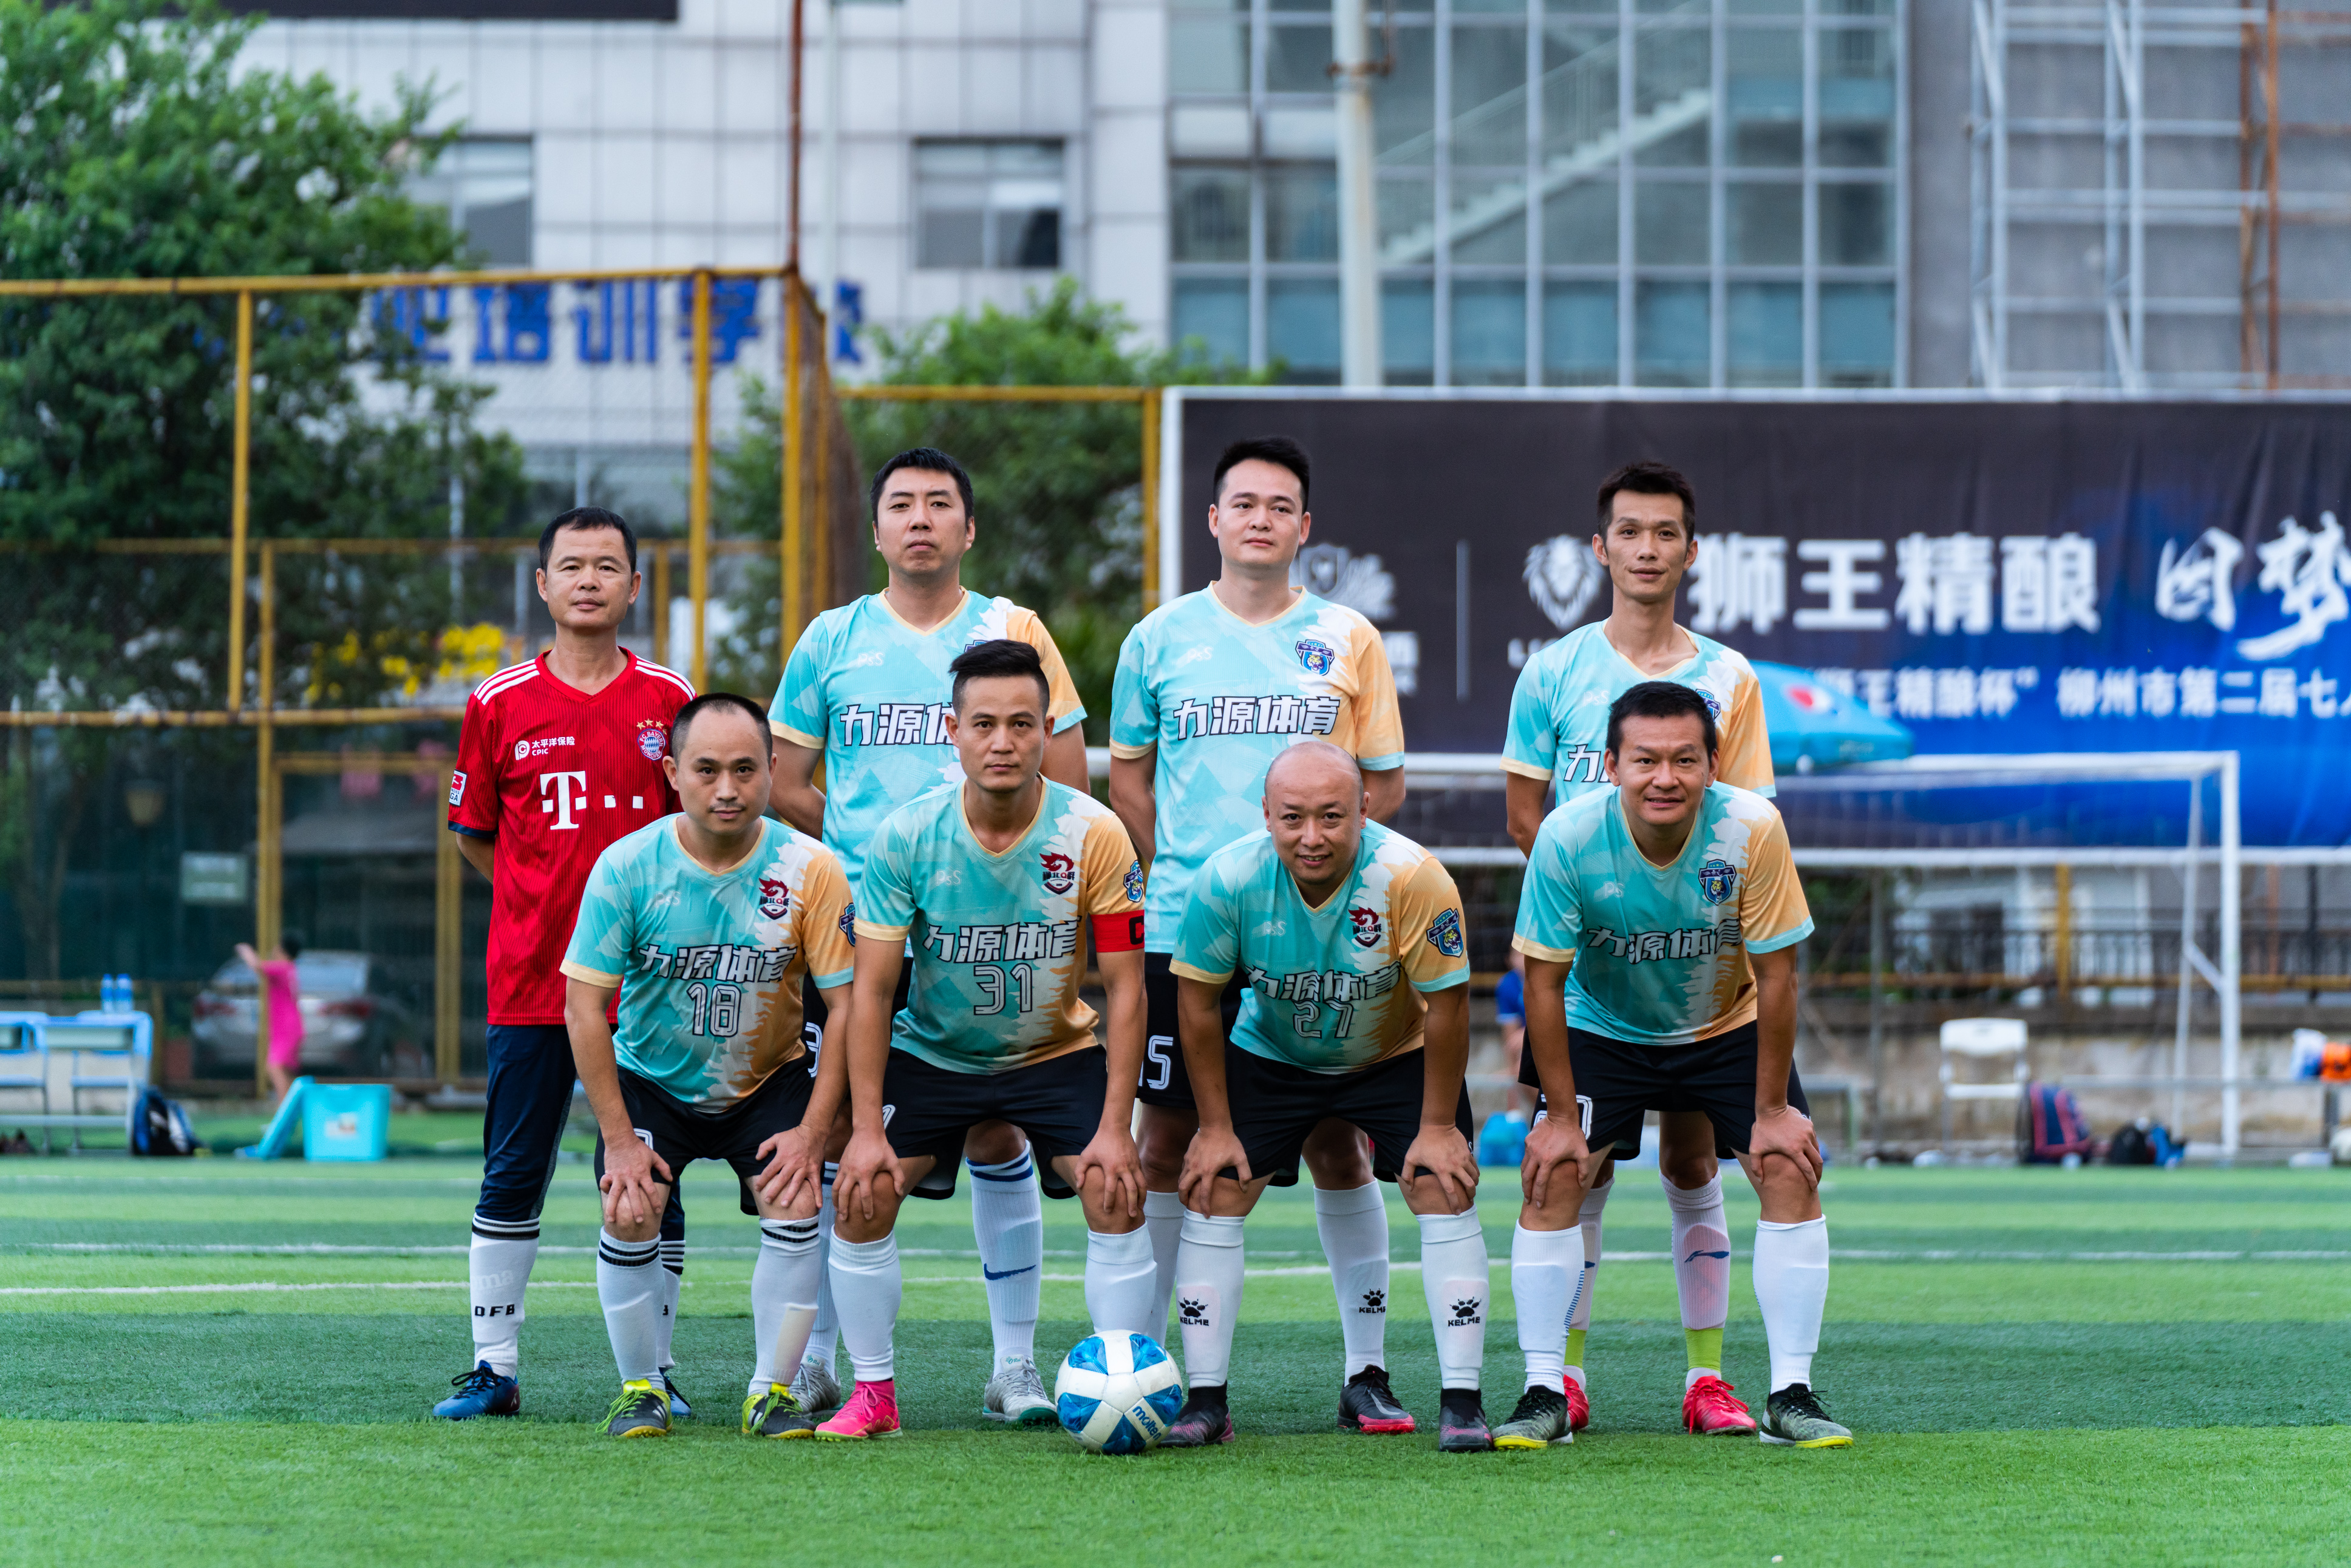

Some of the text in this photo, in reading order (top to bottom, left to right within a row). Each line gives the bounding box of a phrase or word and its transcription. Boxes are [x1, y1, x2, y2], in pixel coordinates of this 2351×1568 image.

[1687, 532, 2101, 635] 狮王精酿
[2057, 666, 2351, 719] 柳州市第二届七
[840, 702, 956, 746] 力源体
[1174, 694, 1340, 741] 力源体育
[531, 736, 575, 749] 太平洋保险
[531, 748, 549, 756] CPIC
[647, 731, 664, 747] BAYERN
[450, 792, 458, 802] GA
[922, 915, 1083, 963] 力源体育
[1129, 915, 1144, 945] C
[1586, 918, 1743, 965] 力源体育
[638, 943, 798, 983] 力源体育
[1244, 960, 1401, 1002] 力源体育
[686, 982, 741, 1037] 18
[973, 963, 1032, 1016] 31
[1293, 999, 1354, 1039] 27
[1179, 1316, 1210, 1326] KELME
[1448, 1316, 1480, 1327] KELME
[1132, 1406, 1162, 1441] molten
